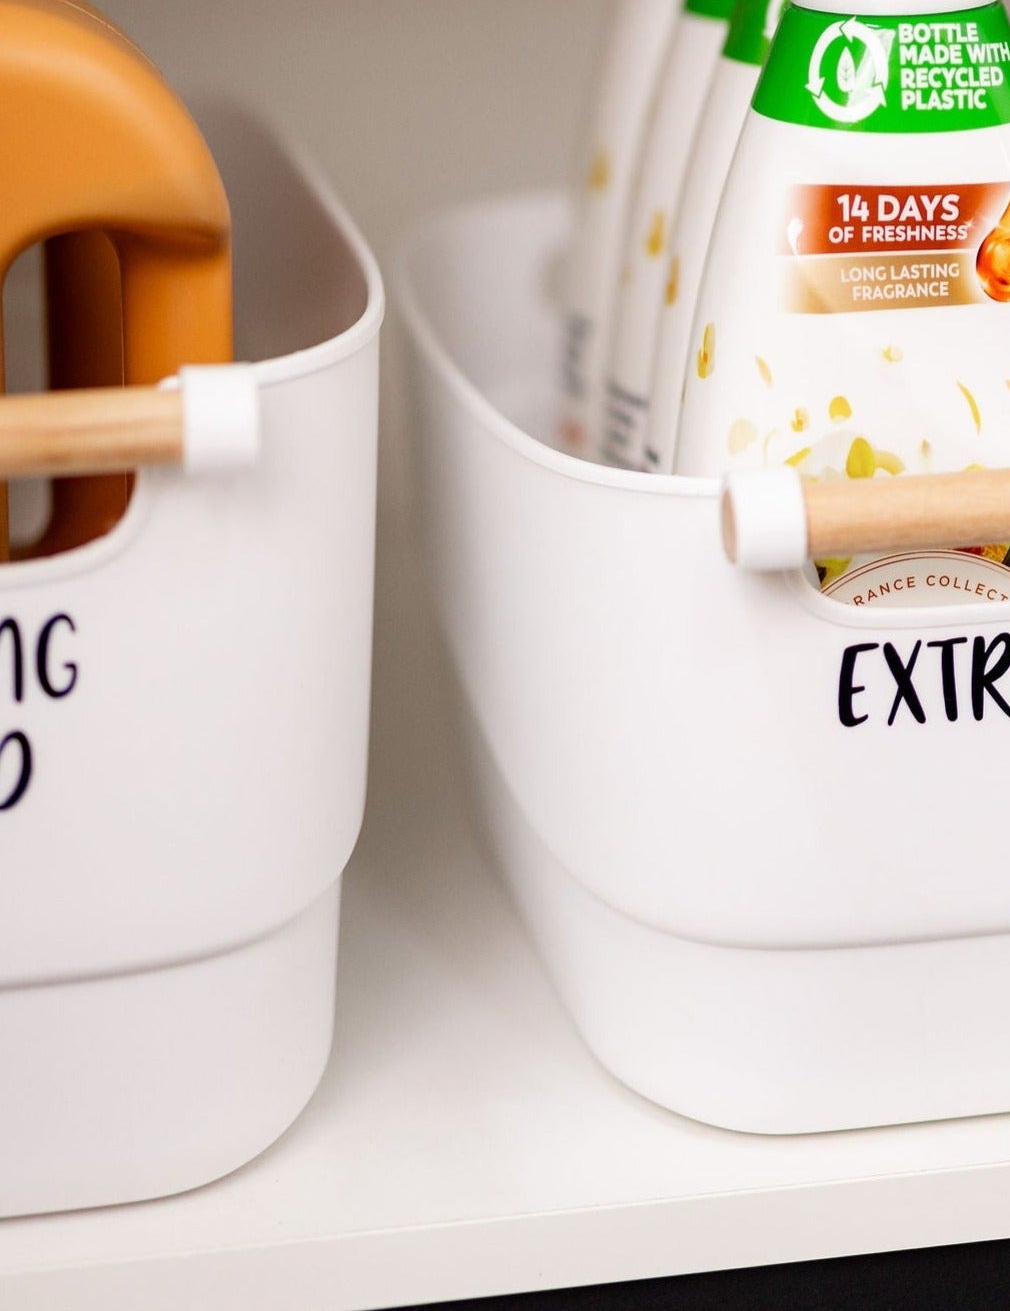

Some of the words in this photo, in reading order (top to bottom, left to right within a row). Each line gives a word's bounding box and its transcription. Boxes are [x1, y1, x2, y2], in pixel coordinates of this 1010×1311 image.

[899, 23, 978, 44] BOTTLE
[900, 44, 962, 65] MADE
[967, 42, 1010, 62] WITH
[901, 67, 1003, 89] RECYCLED
[901, 89, 987, 111] PLASTIC
[836, 194, 870, 222] 14
[877, 194, 960, 222] DAYS
[828, 226, 855, 244] OF
[862, 225, 968, 243] FRESHNESS
[840, 266, 887, 283] LONG
[890, 263, 960, 280] LASTING
[852, 281, 949, 301] FRAGRANCE
[853, 576, 916, 606] RANCE
